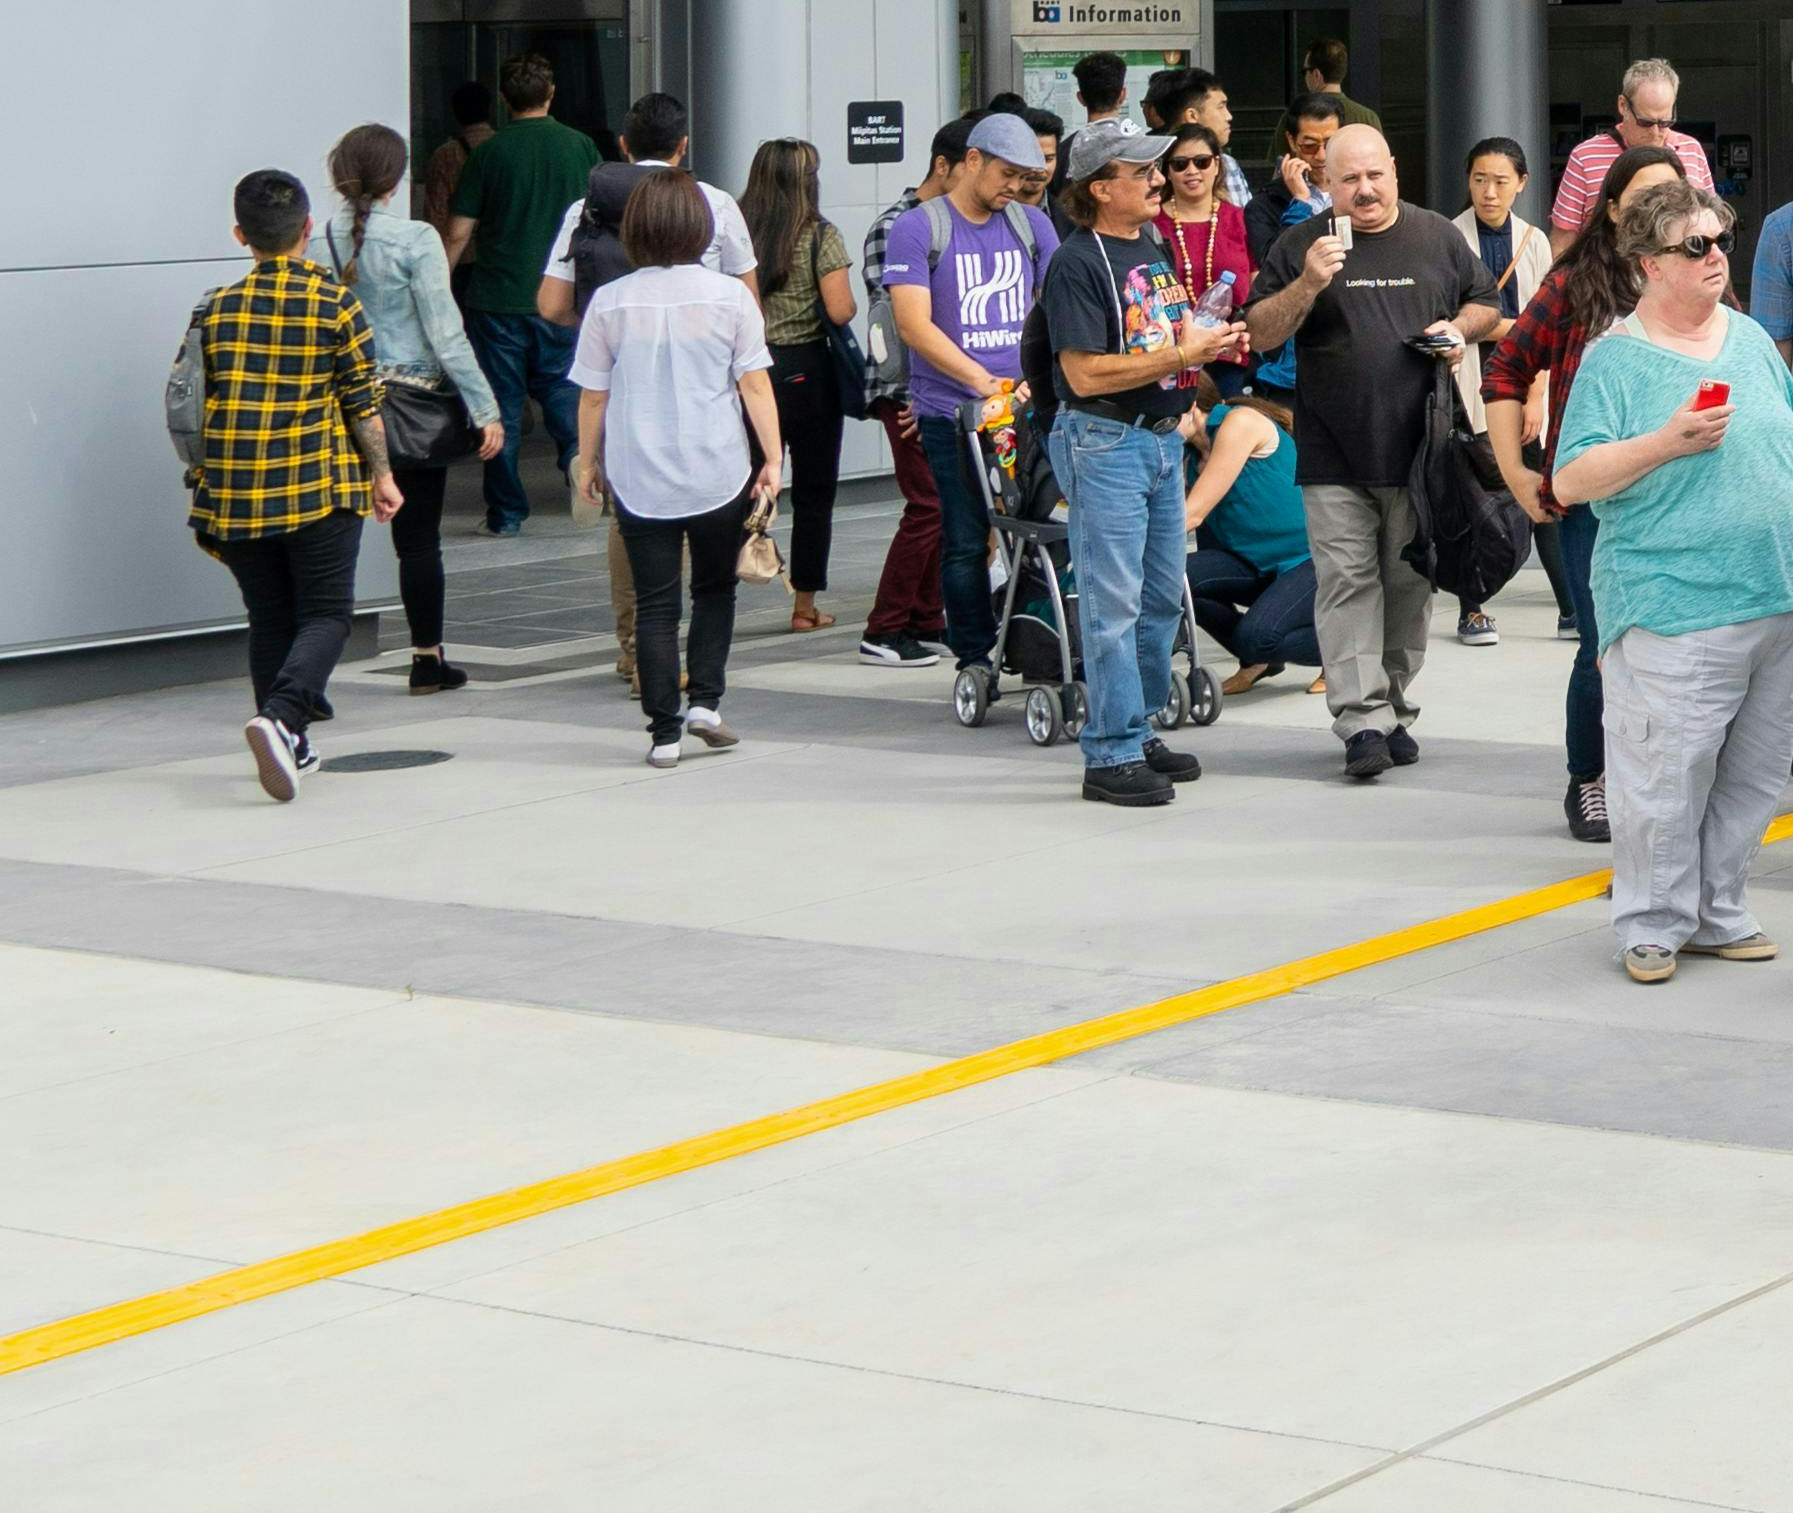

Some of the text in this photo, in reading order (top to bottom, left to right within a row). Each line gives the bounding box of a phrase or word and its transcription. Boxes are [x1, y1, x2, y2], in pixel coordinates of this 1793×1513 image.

[1069, 4, 1181, 22] Information
[1345, 279, 1375, 288] Looking
[1376, 278, 1387, 287] for
